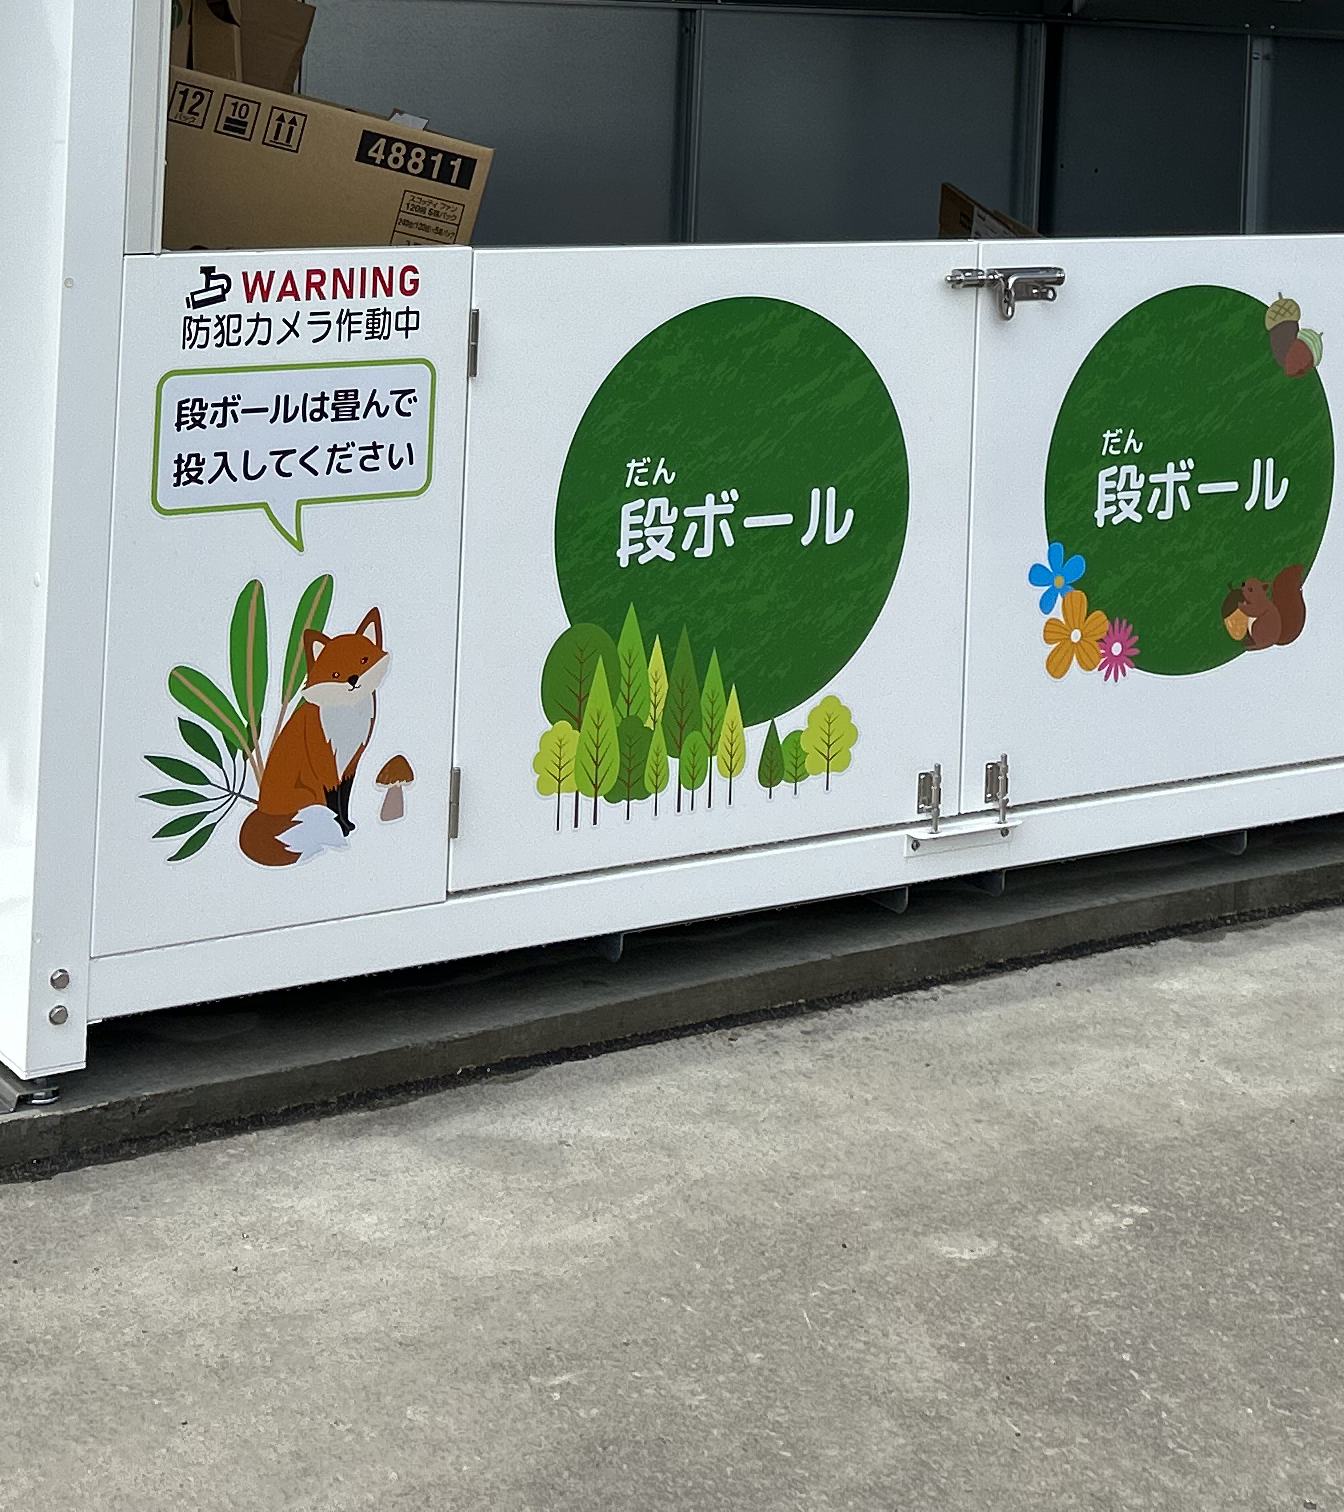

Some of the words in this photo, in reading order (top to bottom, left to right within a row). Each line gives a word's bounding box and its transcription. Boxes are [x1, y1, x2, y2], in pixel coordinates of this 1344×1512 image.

[178, 88, 206, 116] 12
[231, 101, 250, 119] 10
[368, 138, 463, 184] 48811
[242, 265, 420, 303] WARNING
[182, 306, 420, 350] 防犯カメラ作動中
[175, 388, 418, 432] 段ボールは畳んで
[1100, 428, 1143, 455] だん
[172, 441, 414, 488] 投入してください
[625, 458, 675, 488] だん
[1093, 458, 1289, 528] 段ボール
[615, 487, 854, 568] 段ボール
